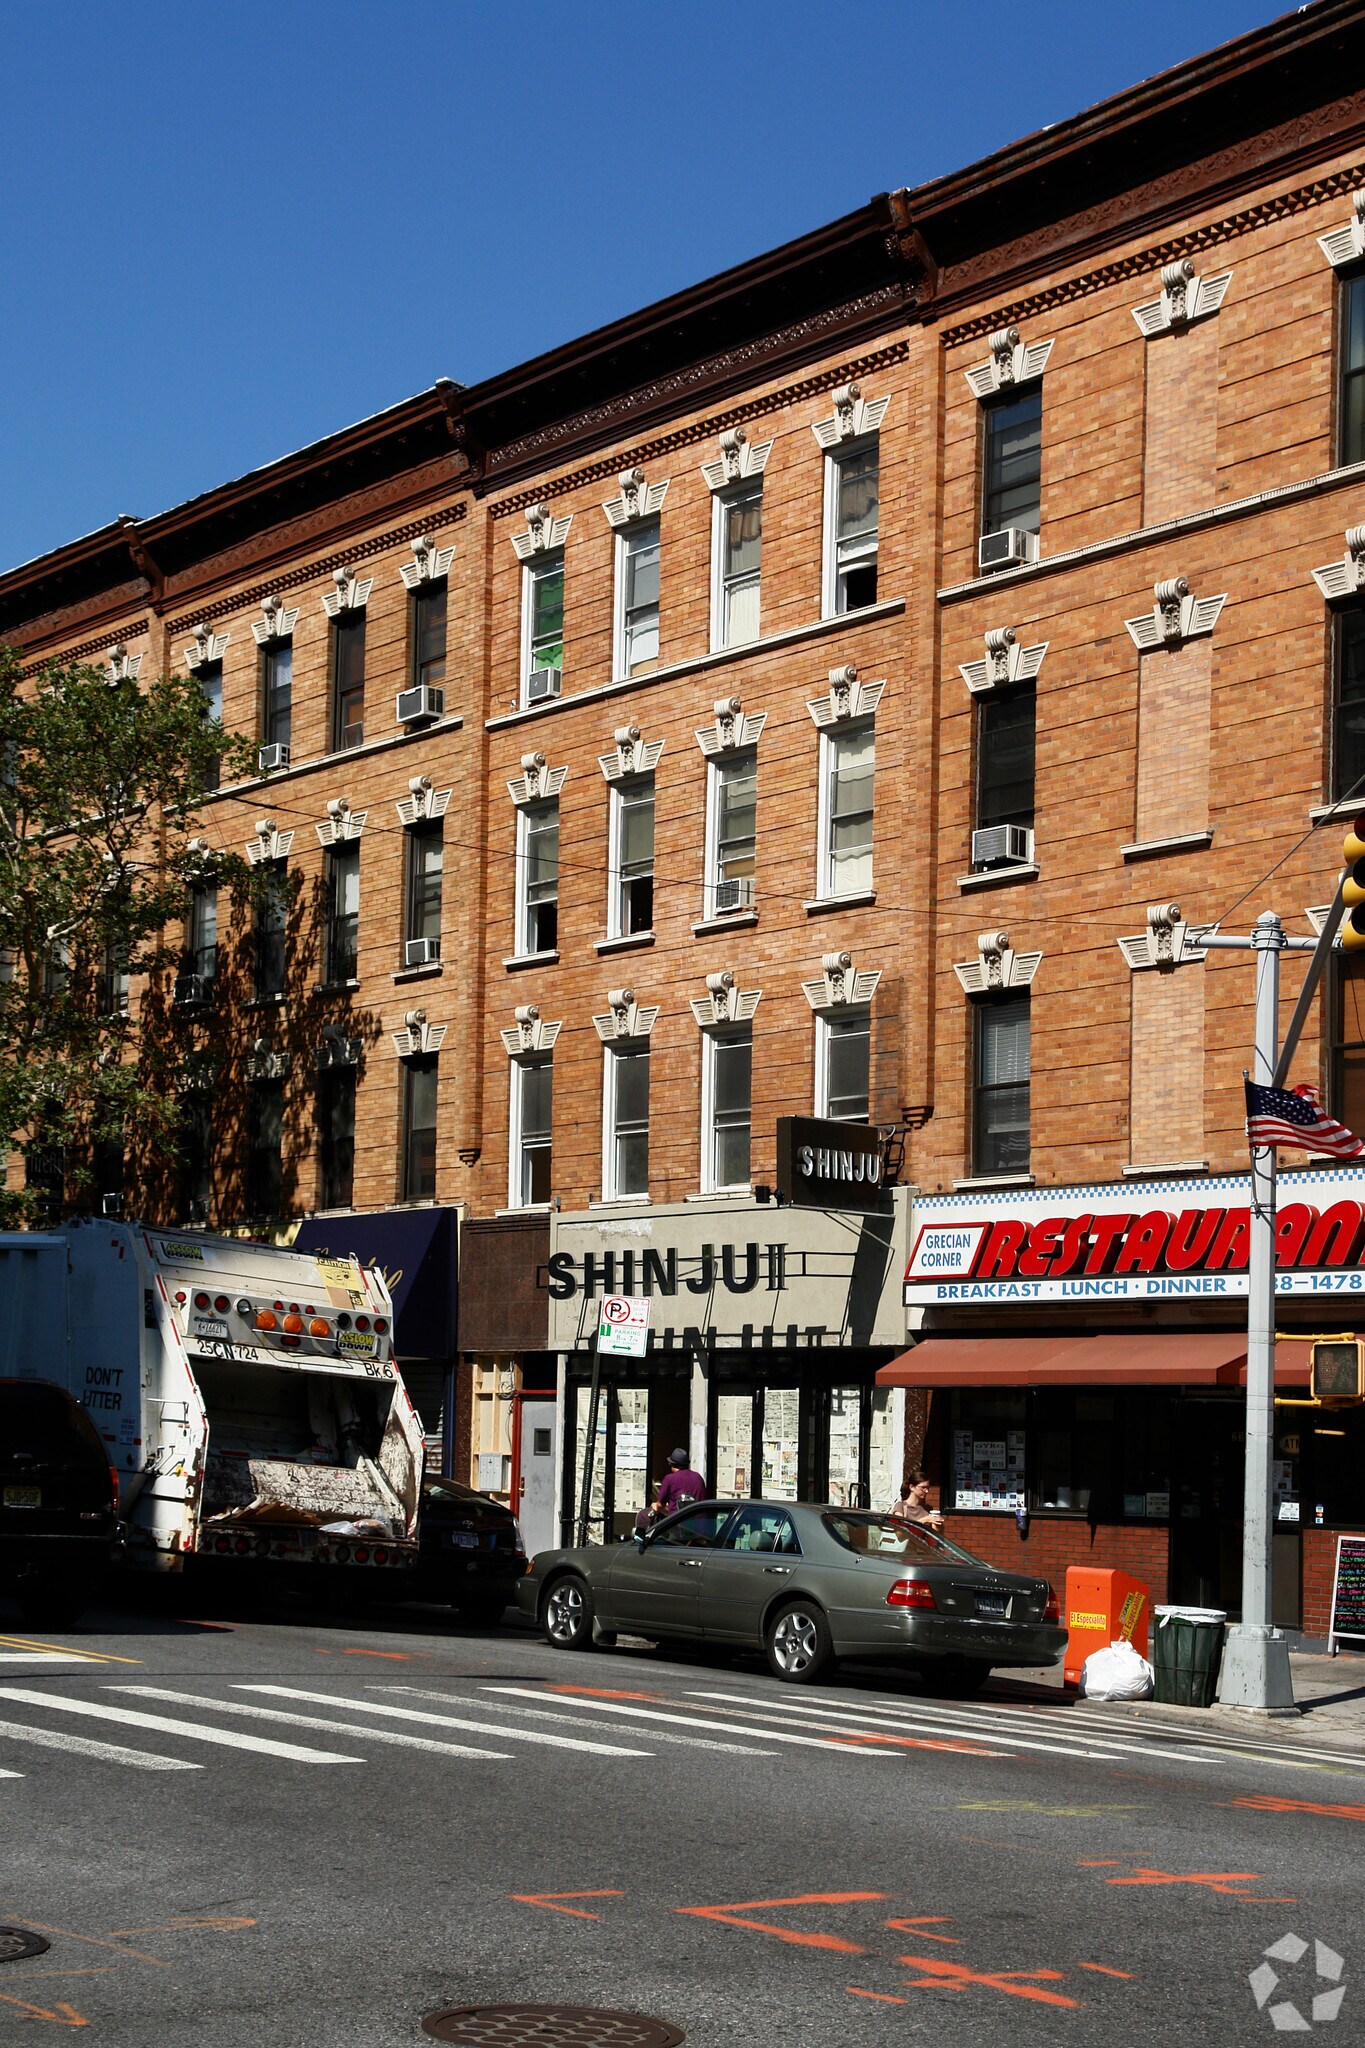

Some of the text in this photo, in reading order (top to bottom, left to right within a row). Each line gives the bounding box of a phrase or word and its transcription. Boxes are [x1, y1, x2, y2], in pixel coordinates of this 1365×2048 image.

[801, 1145, 880, 1184] SHINJU
[925, 1233, 972, 1250] GRECIAN
[976, 1200, 1365, 1277] RESTAURAN
[920, 1251, 963, 1268] CORNER
[548, 1243, 760, 1300] SHINJU
[936, 1282, 1042, 1299] BREAKFAST
[1062, 1280, 1129, 1296] LUNCH
[1146, 1278, 1227, 1295] DINNER
[339, 1342, 374, 1352] DOWN
[349, 1333, 376, 1345] SLOW
[86, 1366, 124, 1387] DON'T
[82, 1389, 122, 1411] LITTER
[1070, 1612, 1106, 1626] El Especialito
